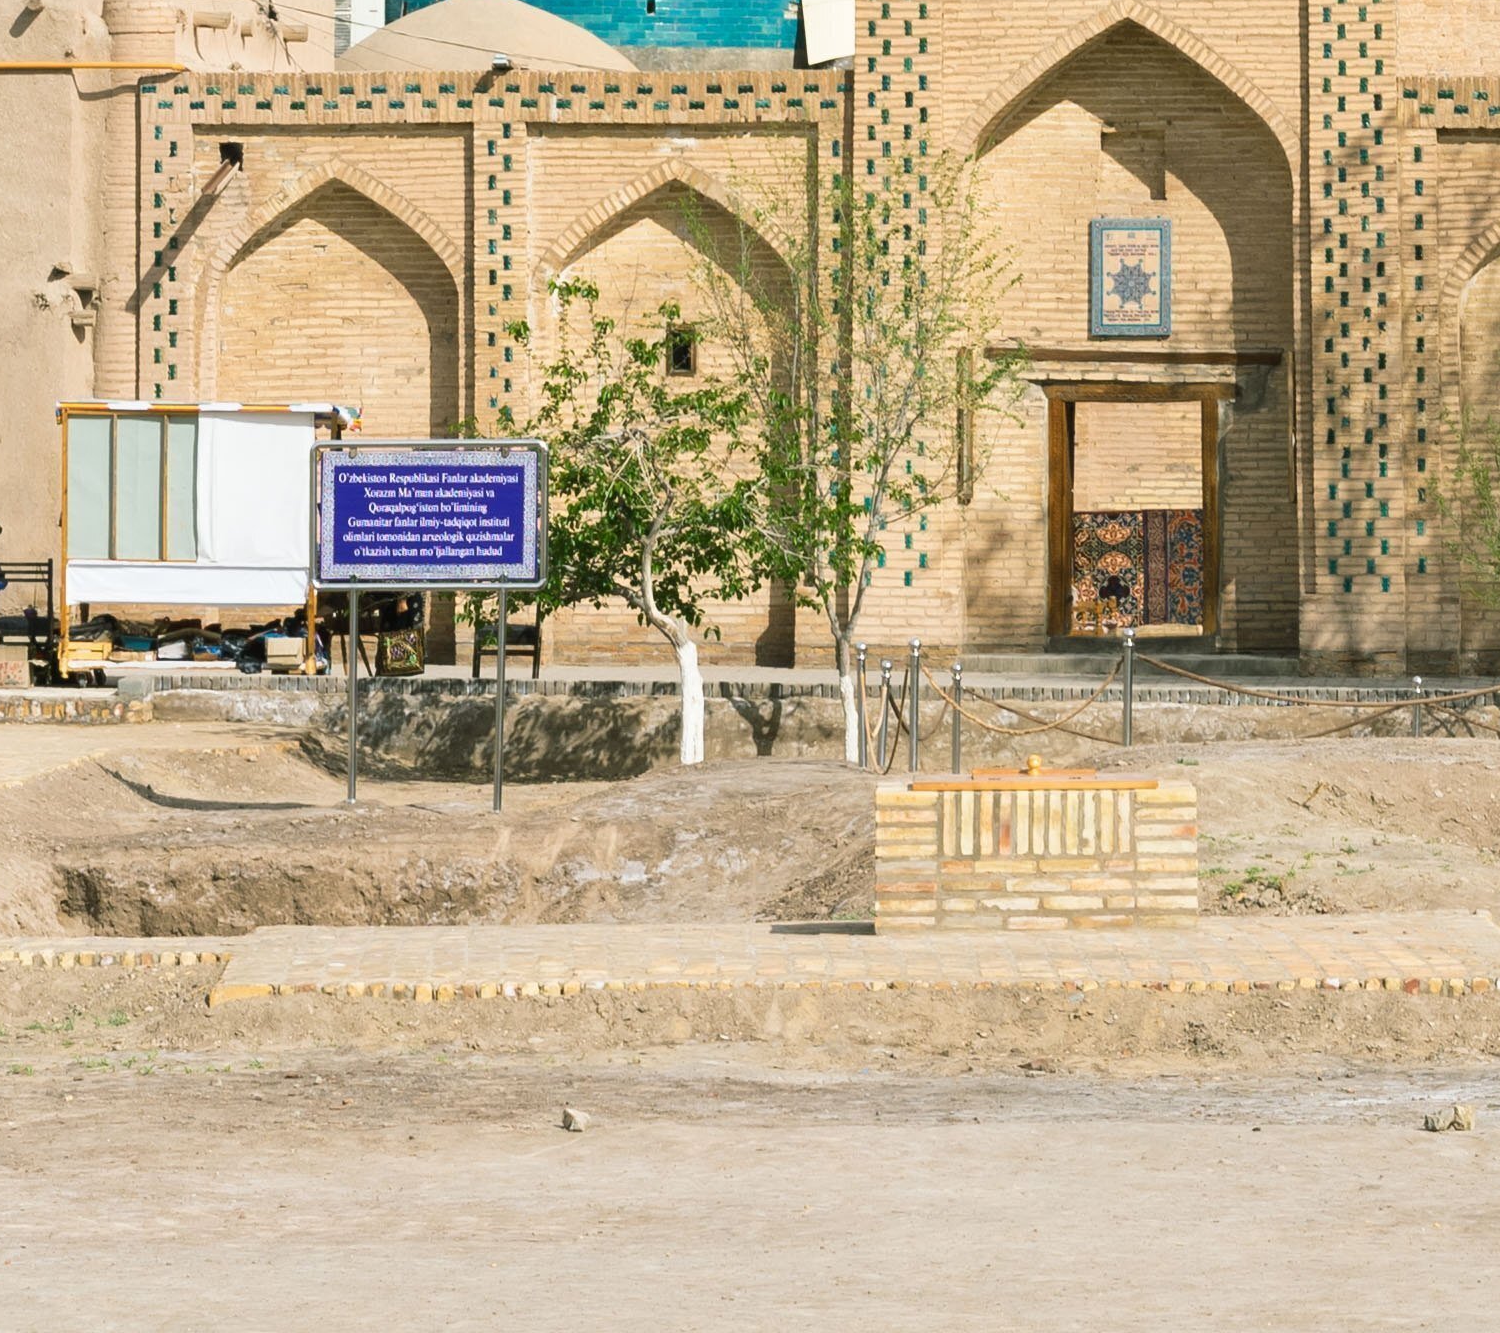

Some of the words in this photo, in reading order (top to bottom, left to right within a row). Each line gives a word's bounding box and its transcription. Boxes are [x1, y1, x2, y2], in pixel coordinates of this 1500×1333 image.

[390, 473, 439, 484] Respublikasi
[442, 473, 468, 483] Fanlar
[469, 473, 518, 485] akademiyasi
[364, 487, 395, 498] Xorazm
[435, 487, 484, 499] akademiyasi
[486, 490, 494, 498] va
[348, 517, 393, 527] Gumanitar
[395, 517, 418, 527] fanlar
[420, 517, 477, 529] ilmiy-tadqiqot
[479, 517, 510, 527] instituti
[343, 531, 375, 542] olimlari
[377, 531, 420, 542] tomonidan
[466, 531, 514, 543] qazishmalar
[392, 546, 417, 557] uchun
[476, 546, 502, 556] hudud
